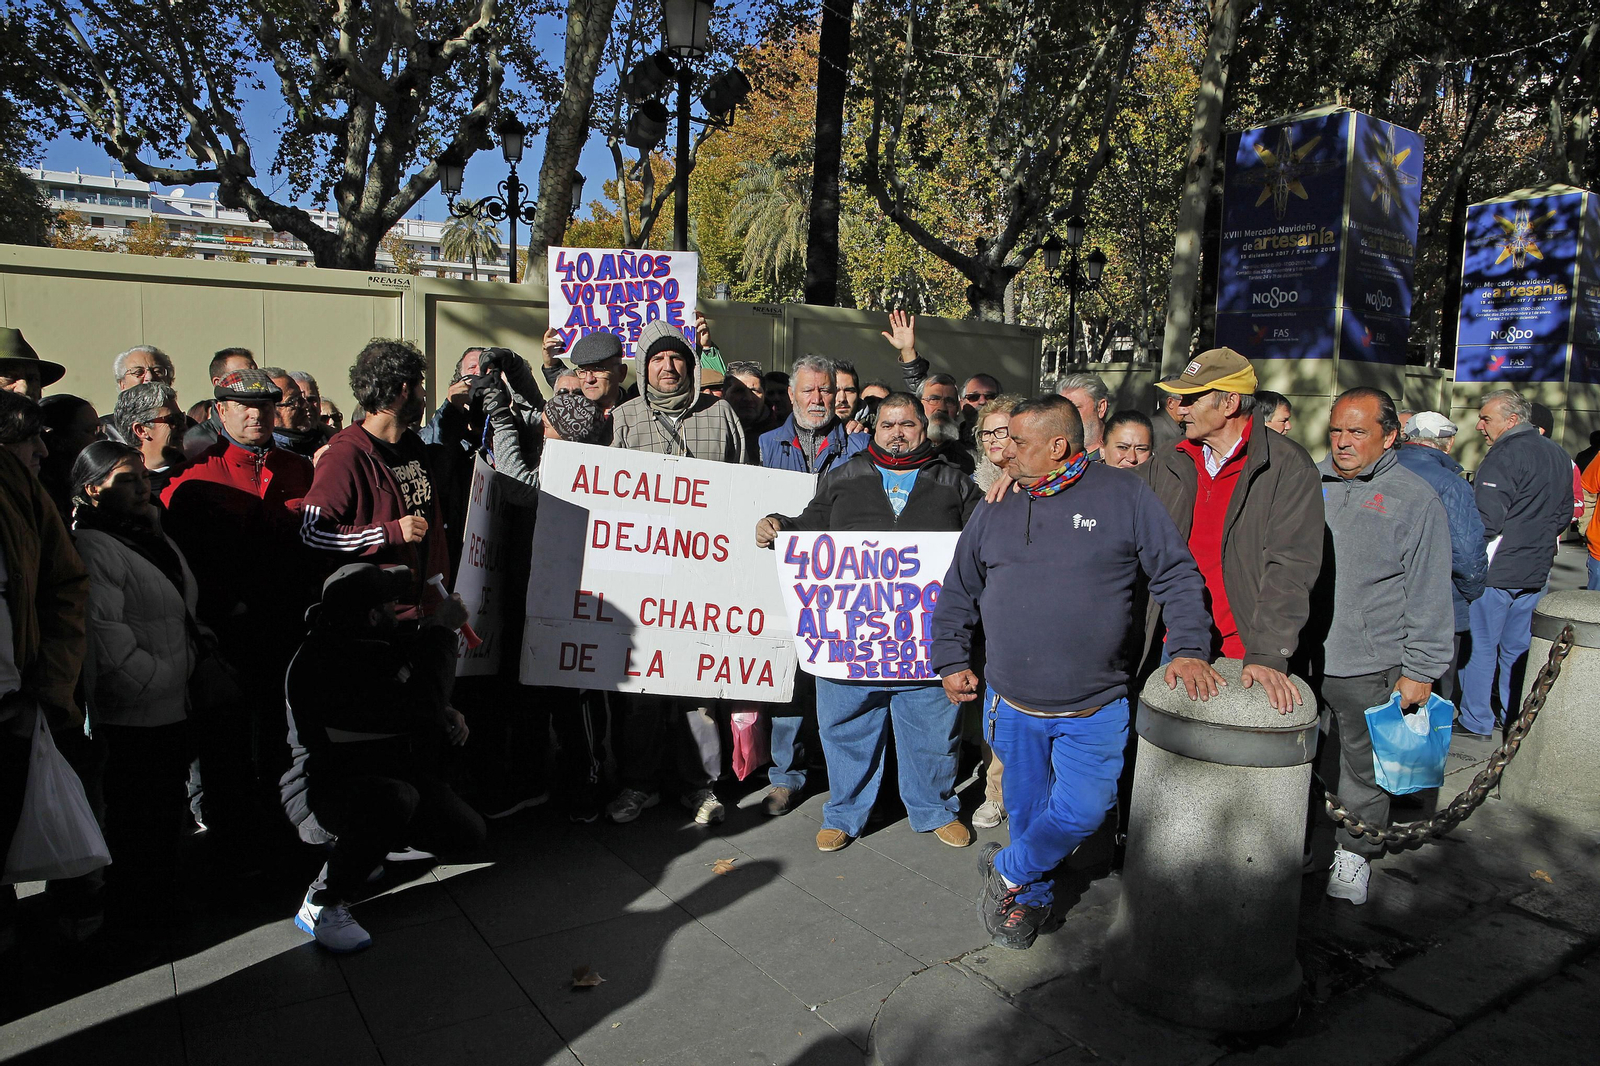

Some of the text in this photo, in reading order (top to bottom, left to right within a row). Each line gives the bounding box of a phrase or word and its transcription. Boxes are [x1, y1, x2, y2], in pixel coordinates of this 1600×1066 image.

[1223, 222, 1316, 240] XVIII Mercado Navideño
[1242, 226, 1335, 251] de artesanía
[555, 249, 672, 283] 40 AÑOS
[1248, 251, 1274, 259] diciembre
[373, 276, 411, 286] REMSA
[561, 277, 680, 306] VOTANDO
[1483, 280, 1515, 288] Mercado
[1516, 278, 1550, 287] Navideño
[1481, 291, 1492, 299] de
[565, 304, 602, 328] AL
[1273, 328, 1289, 338] FAS
[1509, 358, 1525, 366] FAS
[571, 463, 710, 509] ALCALDE
[591, 519, 731, 563] DEJANOS
[784, 533, 921, 581] 40 AÑOS
[793, 580, 944, 614] VOTANDO
[572, 589, 766, 637] EL CHARCO
[796, 607, 842, 640] AL
[558, 641, 775, 688] DE LA PAVA
[805, 638, 825, 665] Y
[827, 639, 875, 664] NOS
